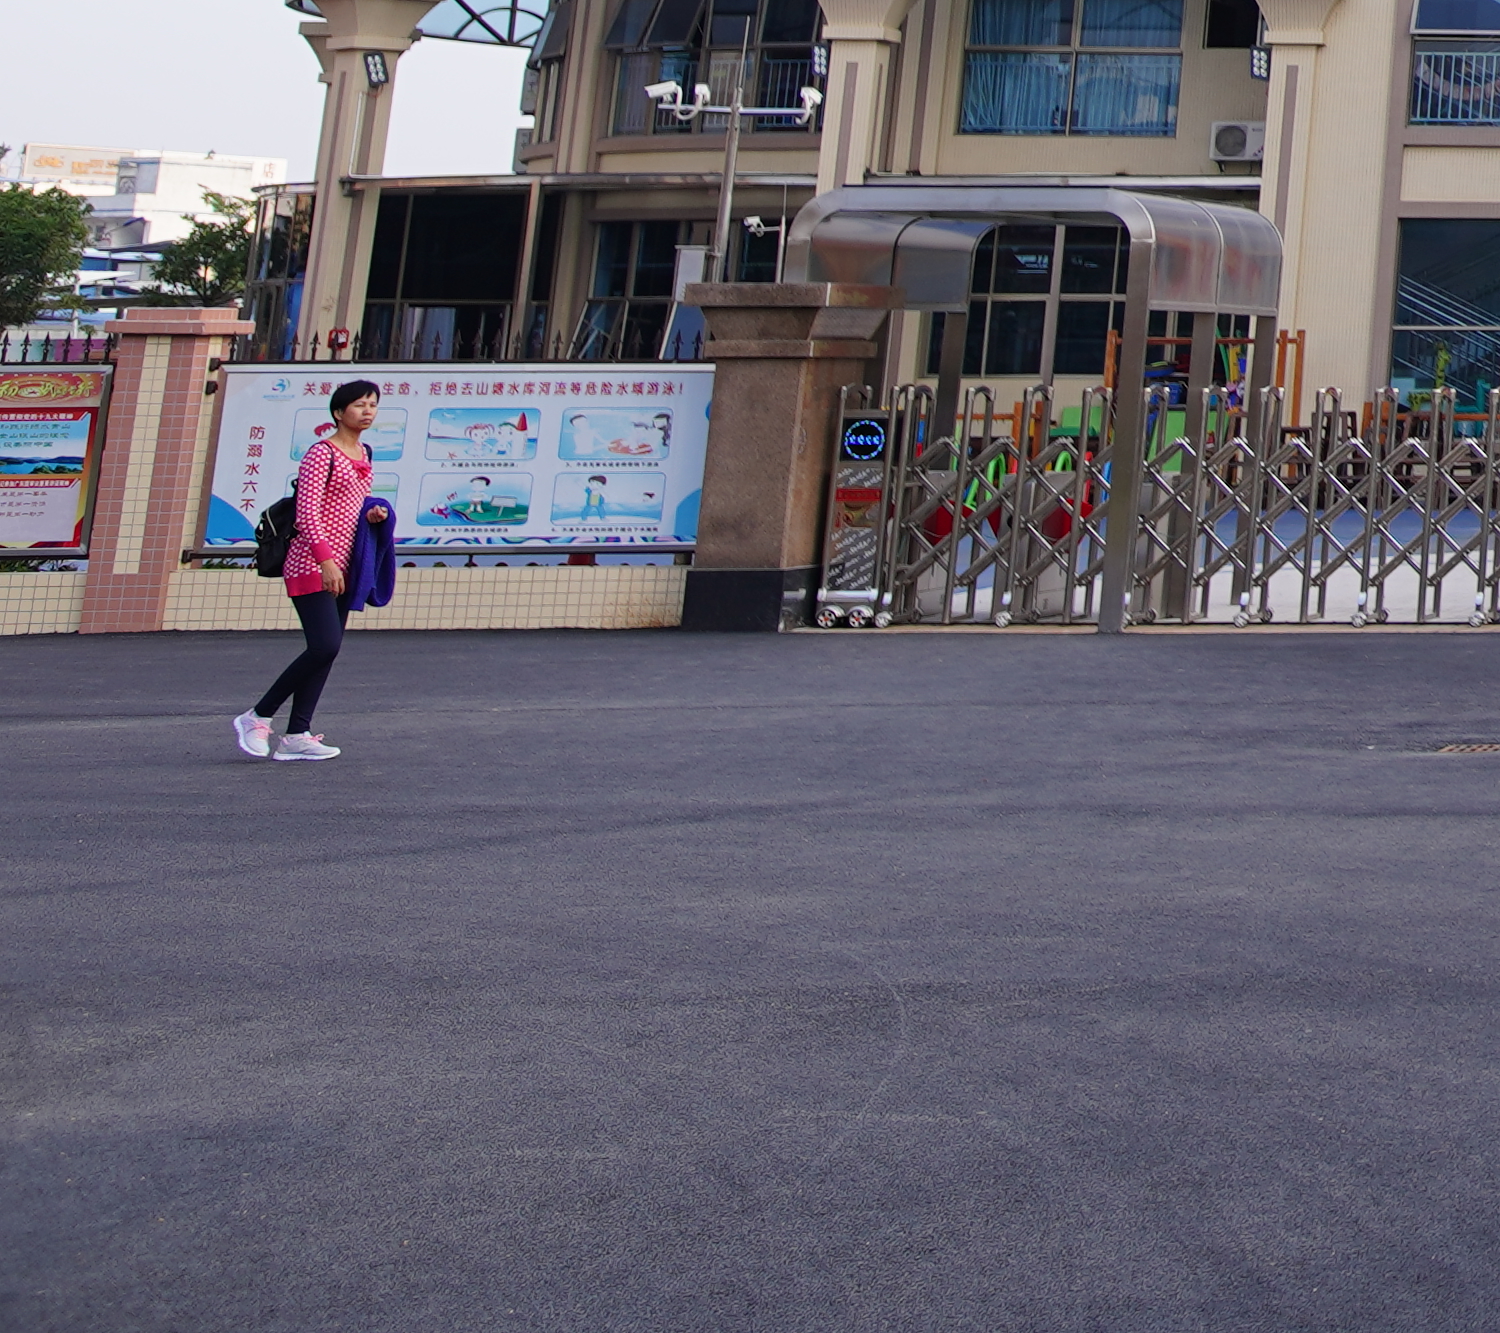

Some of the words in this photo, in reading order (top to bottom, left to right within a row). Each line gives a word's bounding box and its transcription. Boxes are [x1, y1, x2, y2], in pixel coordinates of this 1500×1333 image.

[239, 425, 266, 512] 防溺水六不
